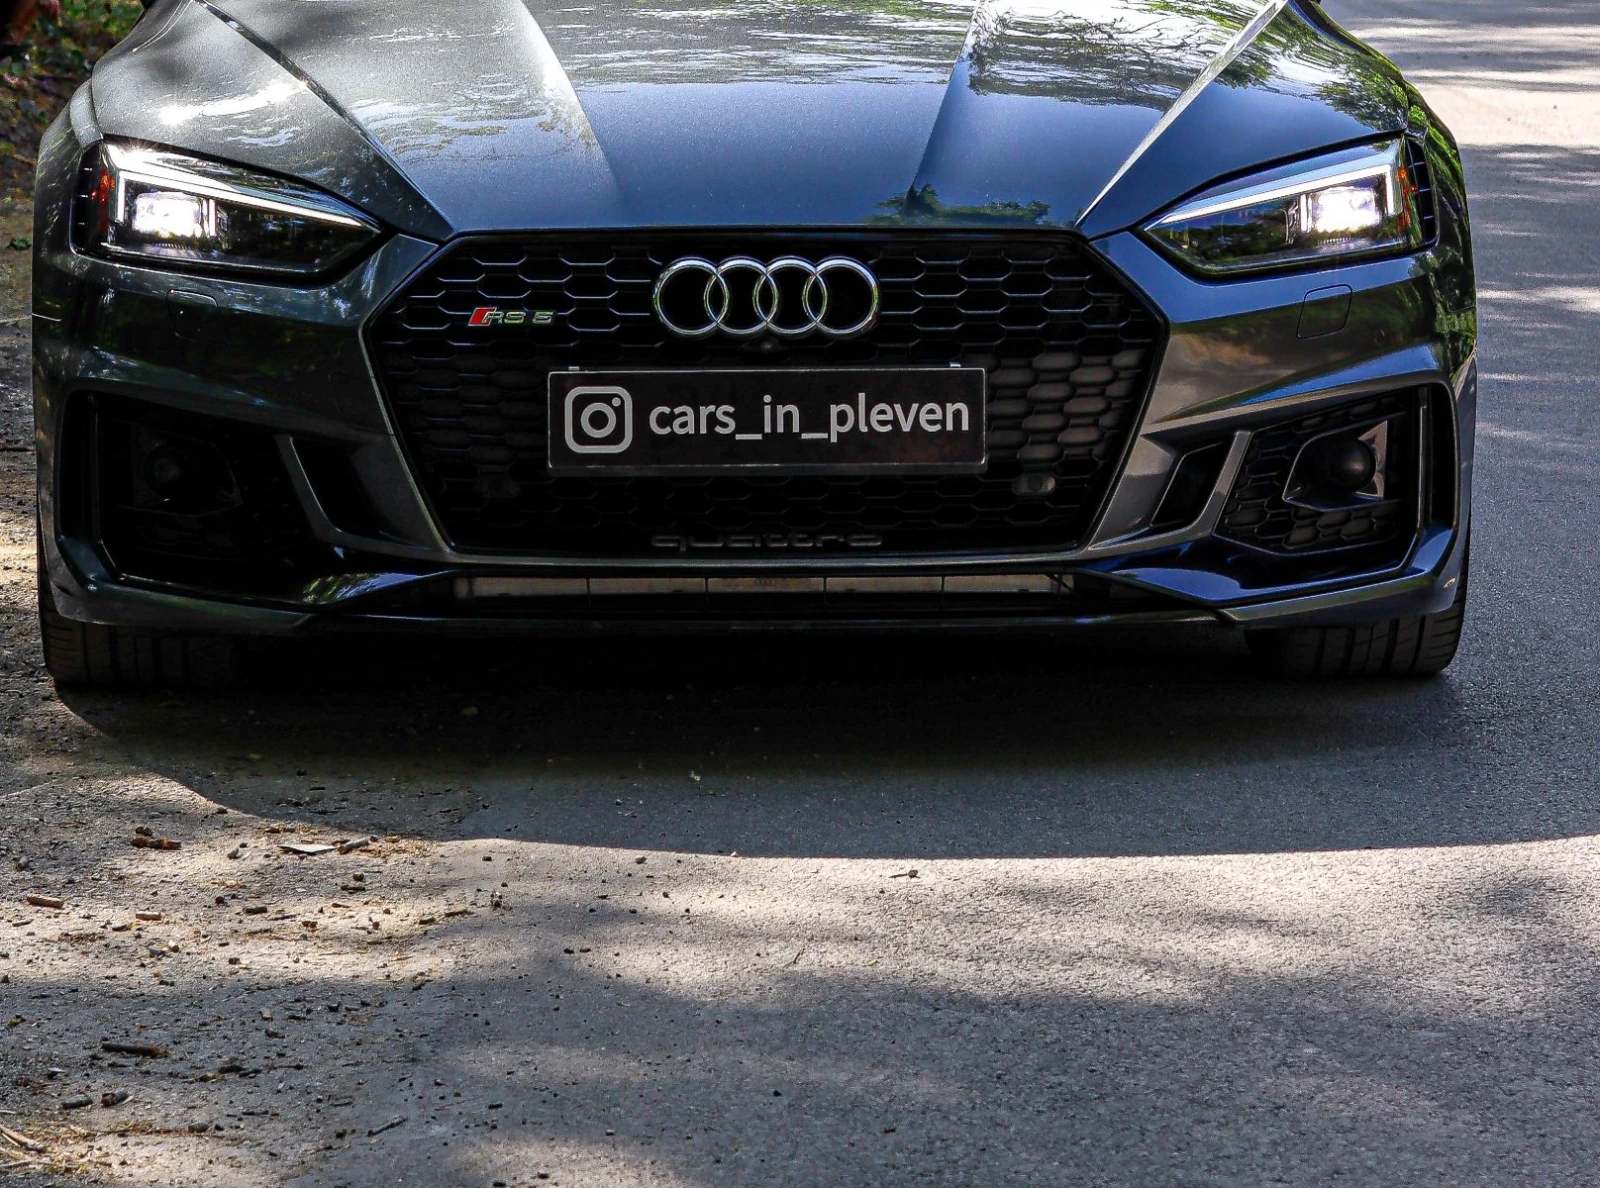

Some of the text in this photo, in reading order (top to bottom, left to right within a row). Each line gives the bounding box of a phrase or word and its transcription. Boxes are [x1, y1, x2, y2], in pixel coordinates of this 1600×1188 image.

[480, 311, 555, 324] RS 5
[649, 392, 969, 443] cars_in_pleven
[650, 533, 882, 552] quattro
